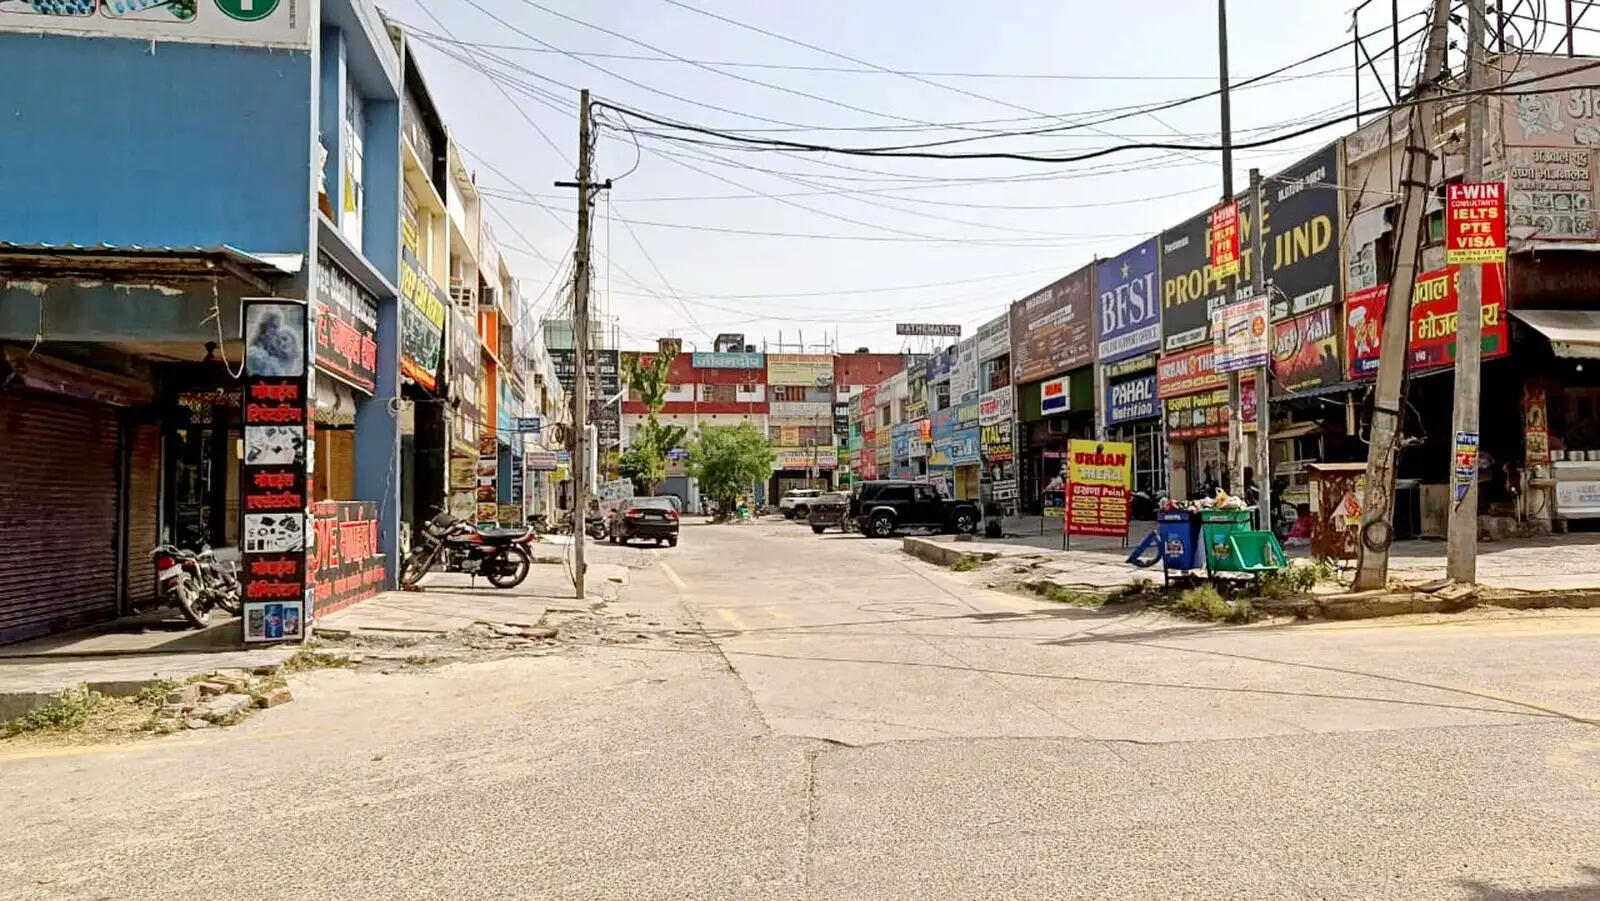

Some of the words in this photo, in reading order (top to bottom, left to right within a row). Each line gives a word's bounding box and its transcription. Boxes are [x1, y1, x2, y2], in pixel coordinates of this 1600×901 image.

[1451, 184, 1499, 200] I-WIN
[1453, 207, 1498, 220] IELTS
[1460, 221, 1491, 234] PTE
[1273, 214, 1332, 271] JIND
[1456, 235, 1496, 248] VISA
[1101, 272, 1156, 336] BFSI
[899, 323, 960, 336] MATHEMATICS
[1112, 378, 1153, 405] PAHAL
[1112, 400, 1153, 420] Nutrition
[1075, 452, 1126, 466] URBAN
[1102, 487, 1125, 498] Point
